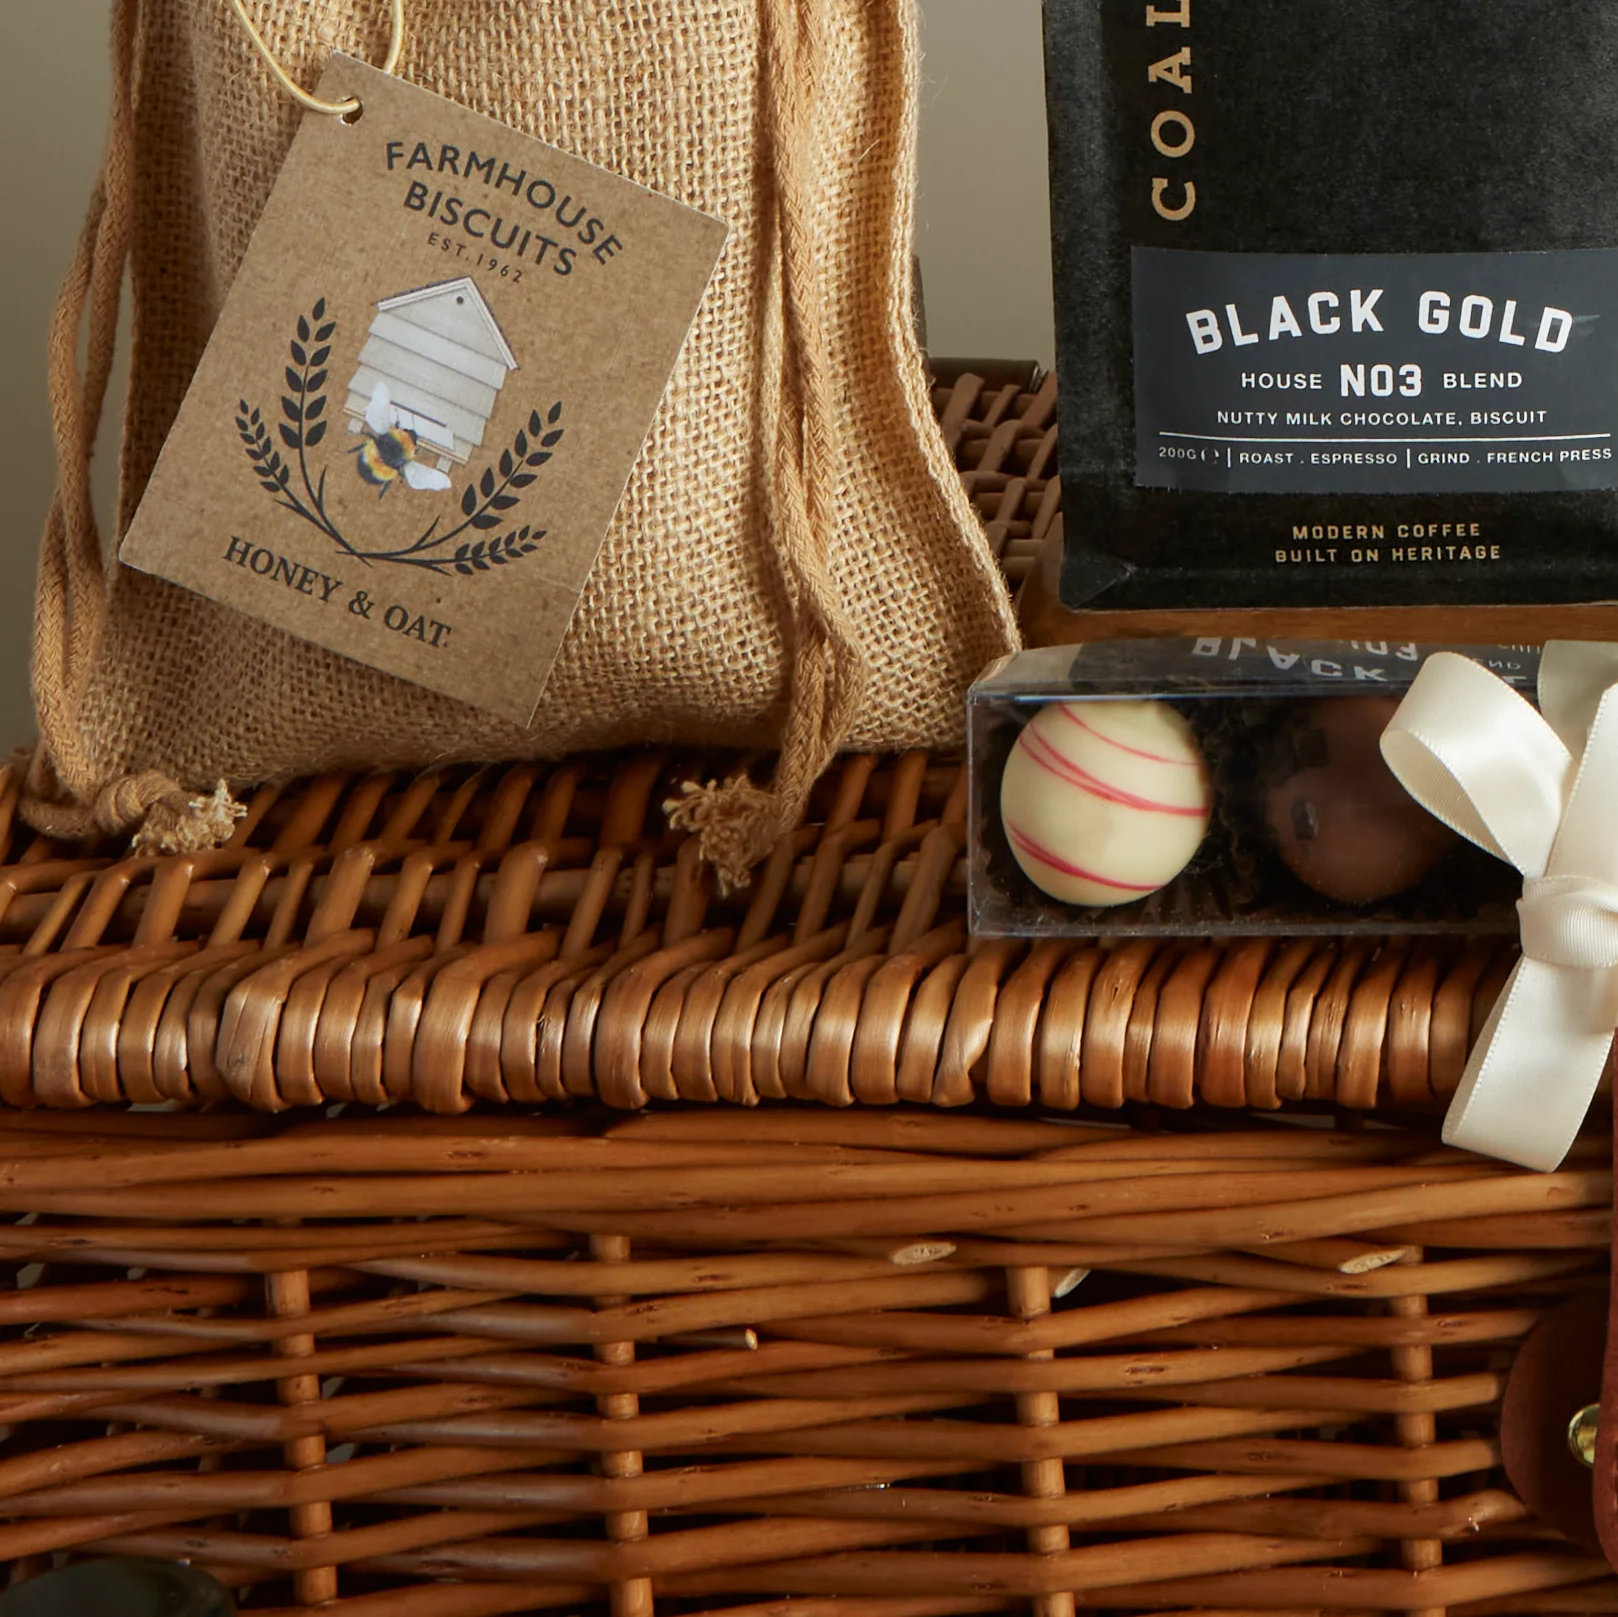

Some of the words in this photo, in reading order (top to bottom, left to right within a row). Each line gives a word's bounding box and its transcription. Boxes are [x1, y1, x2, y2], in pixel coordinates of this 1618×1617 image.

[385, 141, 624, 265] FARMHOUSE
[402, 181, 578, 276] BISCUITS
[1186, 289, 1384, 355] BLACK
[1418, 290, 1573, 353] GOLD
[1241, 372, 1322, 390] HOUSE
[1443, 372, 1523, 389] BLEND
[1217, 410, 1278, 426] NUTTY
[1286, 411, 1332, 426] MILK
[1340, 411, 1464, 427] CHOCOLATE,
[1470, 410, 1547, 425] BISCUIT
[1158, 447, 1197, 460] 200G
[1239, 453, 1294, 465] ROAST
[1310, 452, 1398, 465] ESPRESSO
[1418, 453, 1470, 465] GRIND
[1487, 451, 1553, 463] FRENCH
[1559, 447, 1612, 462] PRESS
[1293, 525, 1384, 540] MODERN
[1398, 523, 1480, 538] COFFEE
[1275, 549, 1335, 562] BUILT
[1352, 548, 1378, 562] ON
[1393, 545, 1501, 560] HERITAGE
[223, 535, 343, 603] HONEY
[348, 590, 375, 619] &
